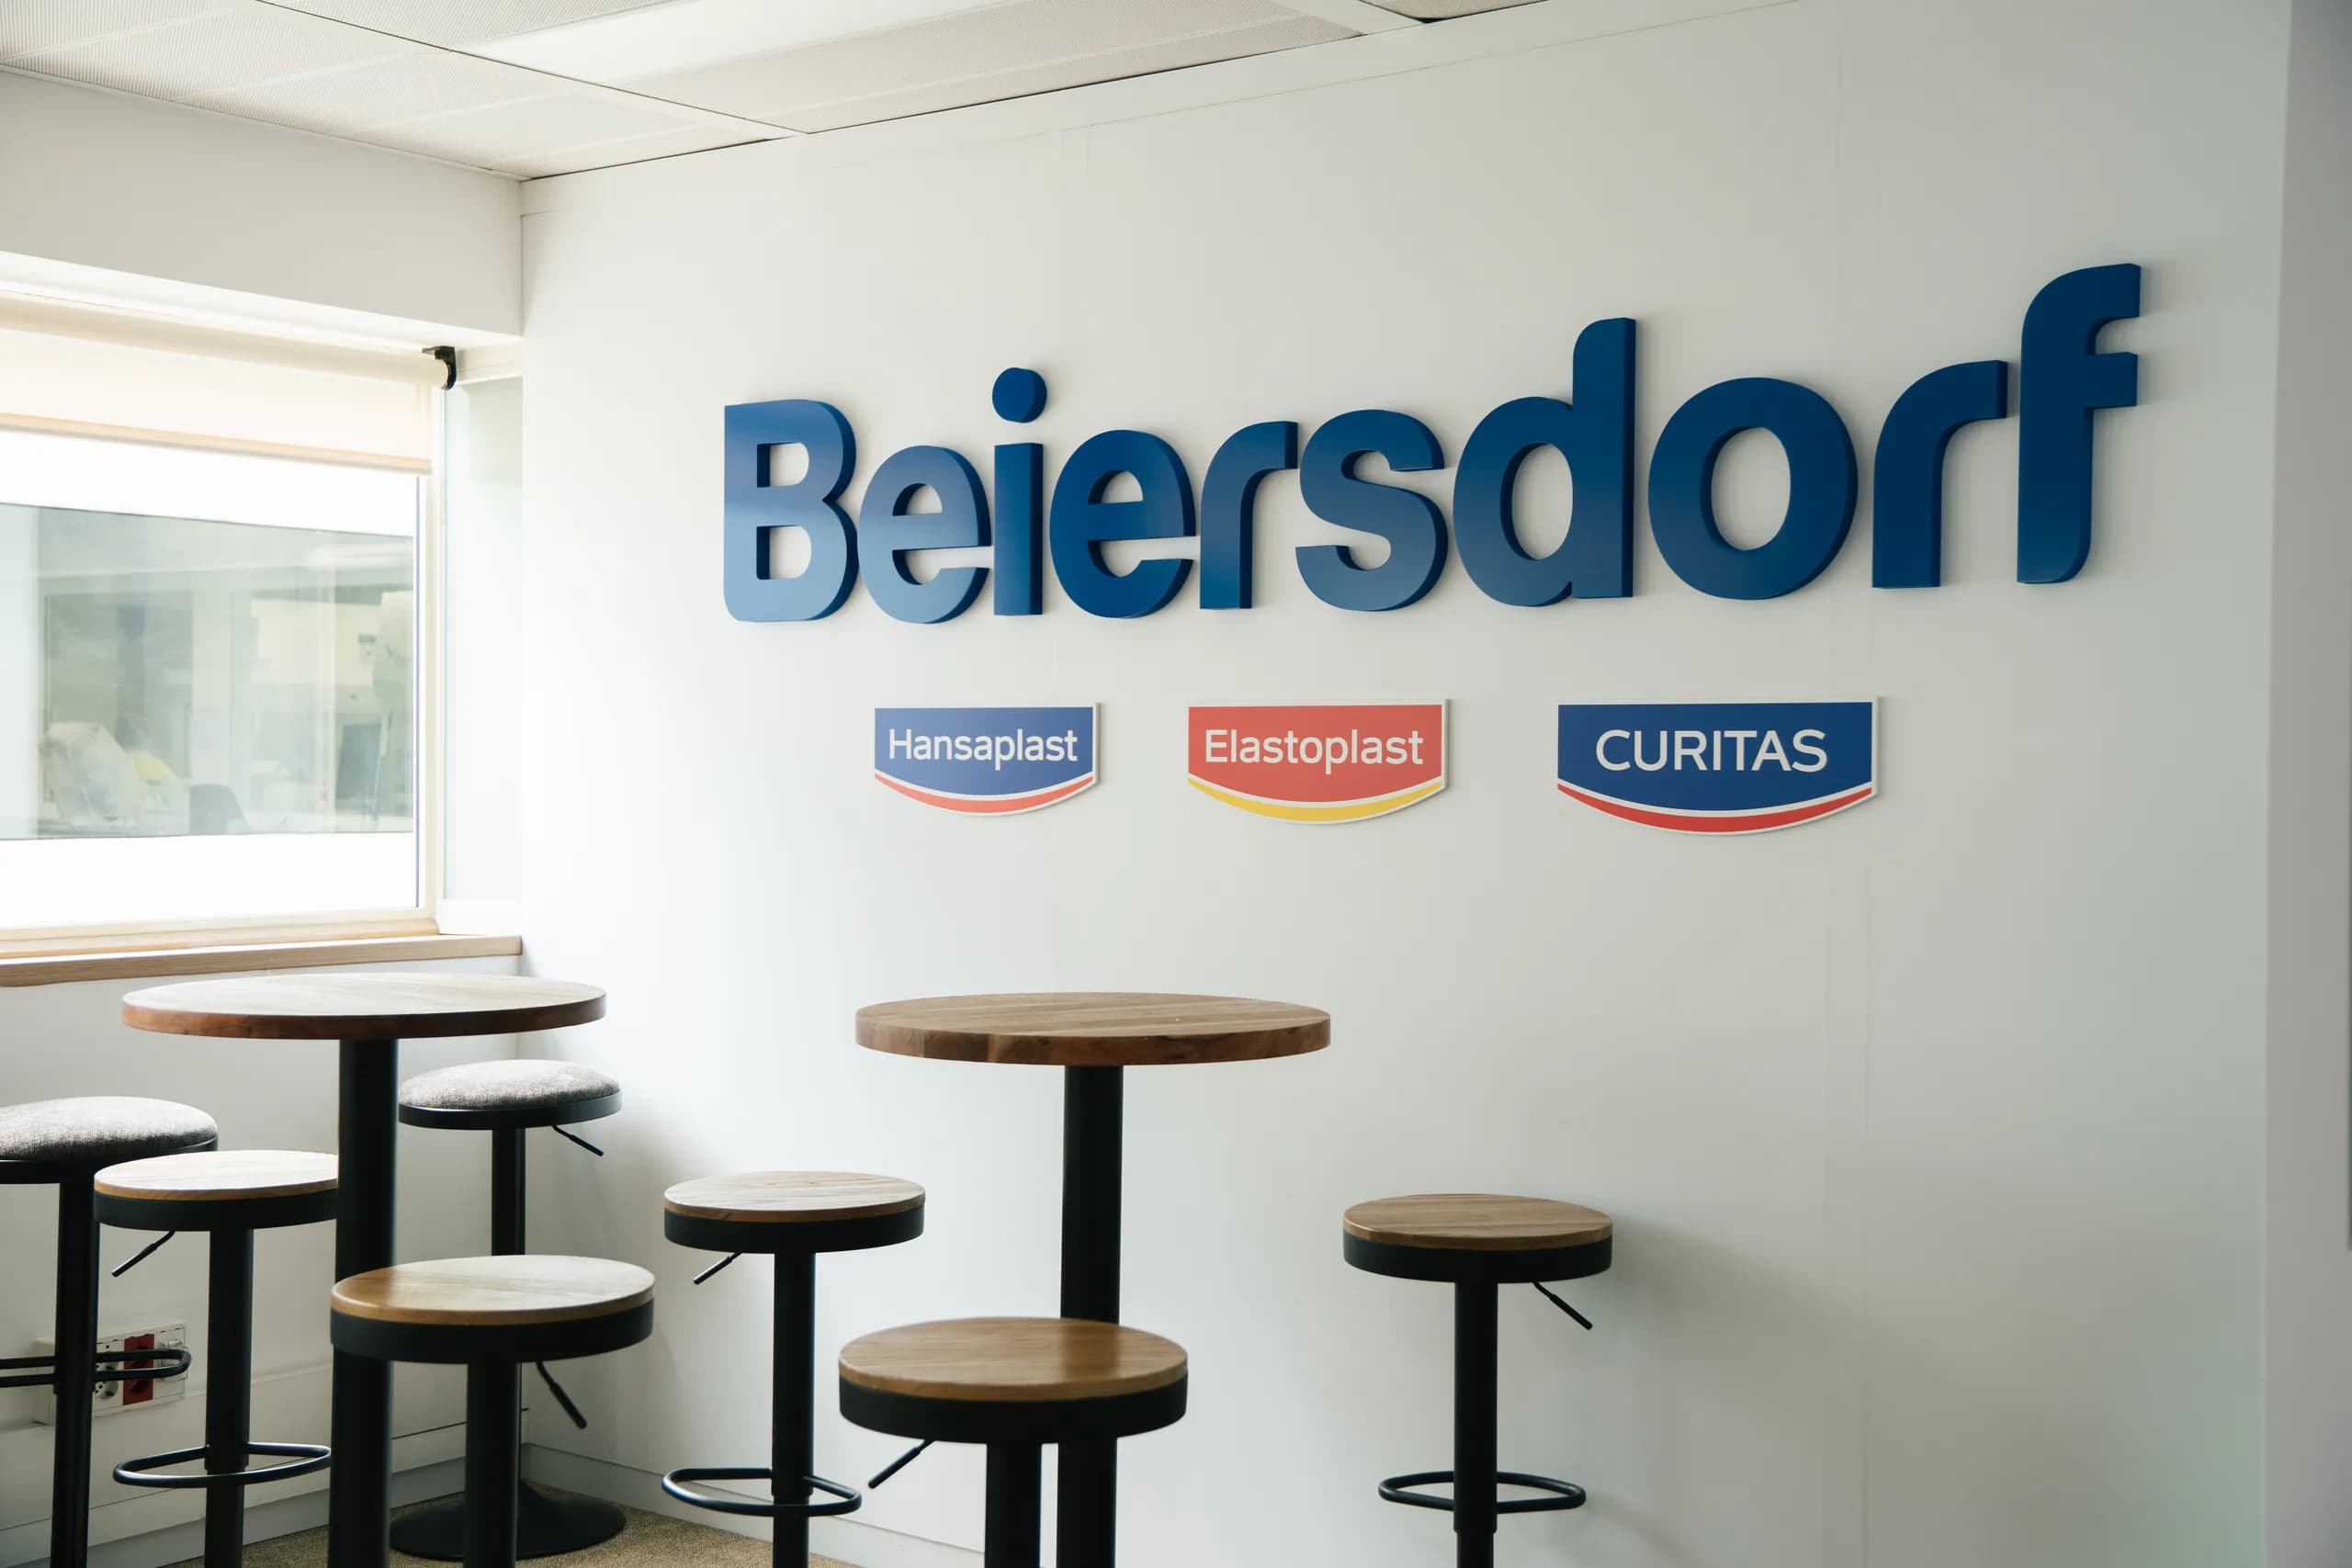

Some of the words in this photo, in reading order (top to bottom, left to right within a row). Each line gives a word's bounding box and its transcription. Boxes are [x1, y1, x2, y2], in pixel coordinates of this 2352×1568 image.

[724, 263, 2143, 626] Beiersdorf
[888, 728, 1079, 771] Hansaplast
[1205, 728, 1423, 774] Elastoplast
[1596, 728, 1828, 773] CURITAS
